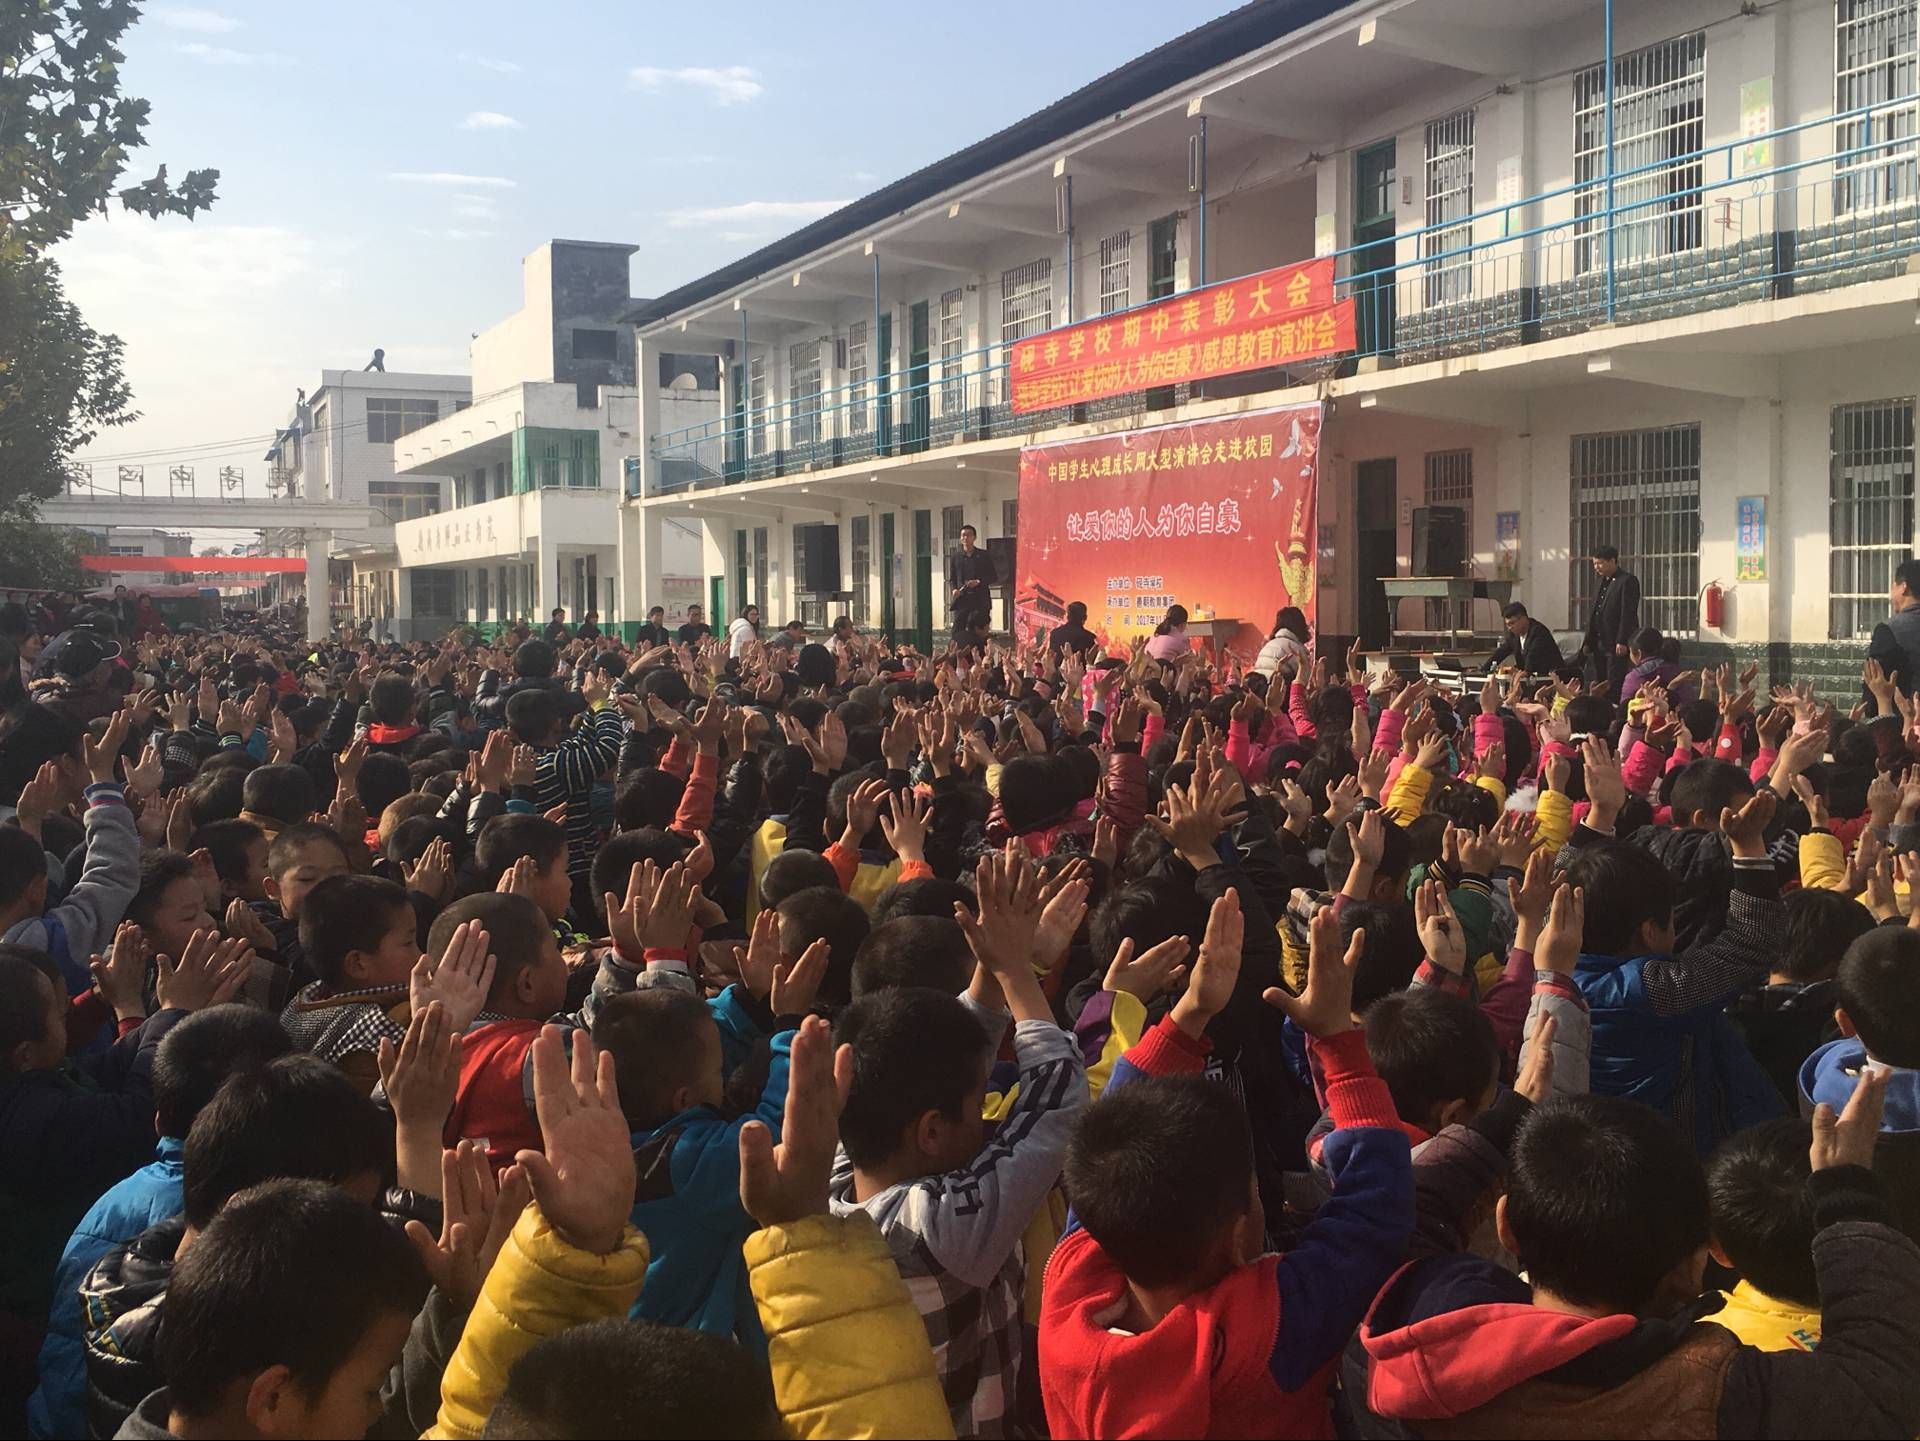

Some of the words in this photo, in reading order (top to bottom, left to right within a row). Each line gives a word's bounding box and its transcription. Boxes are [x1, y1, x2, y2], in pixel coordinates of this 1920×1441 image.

[1048, 434, 1273, 483] 中国学生心理成长网大型演讲会走进校园
[1066, 498, 1241, 542] 让爱你的人为你自豪
